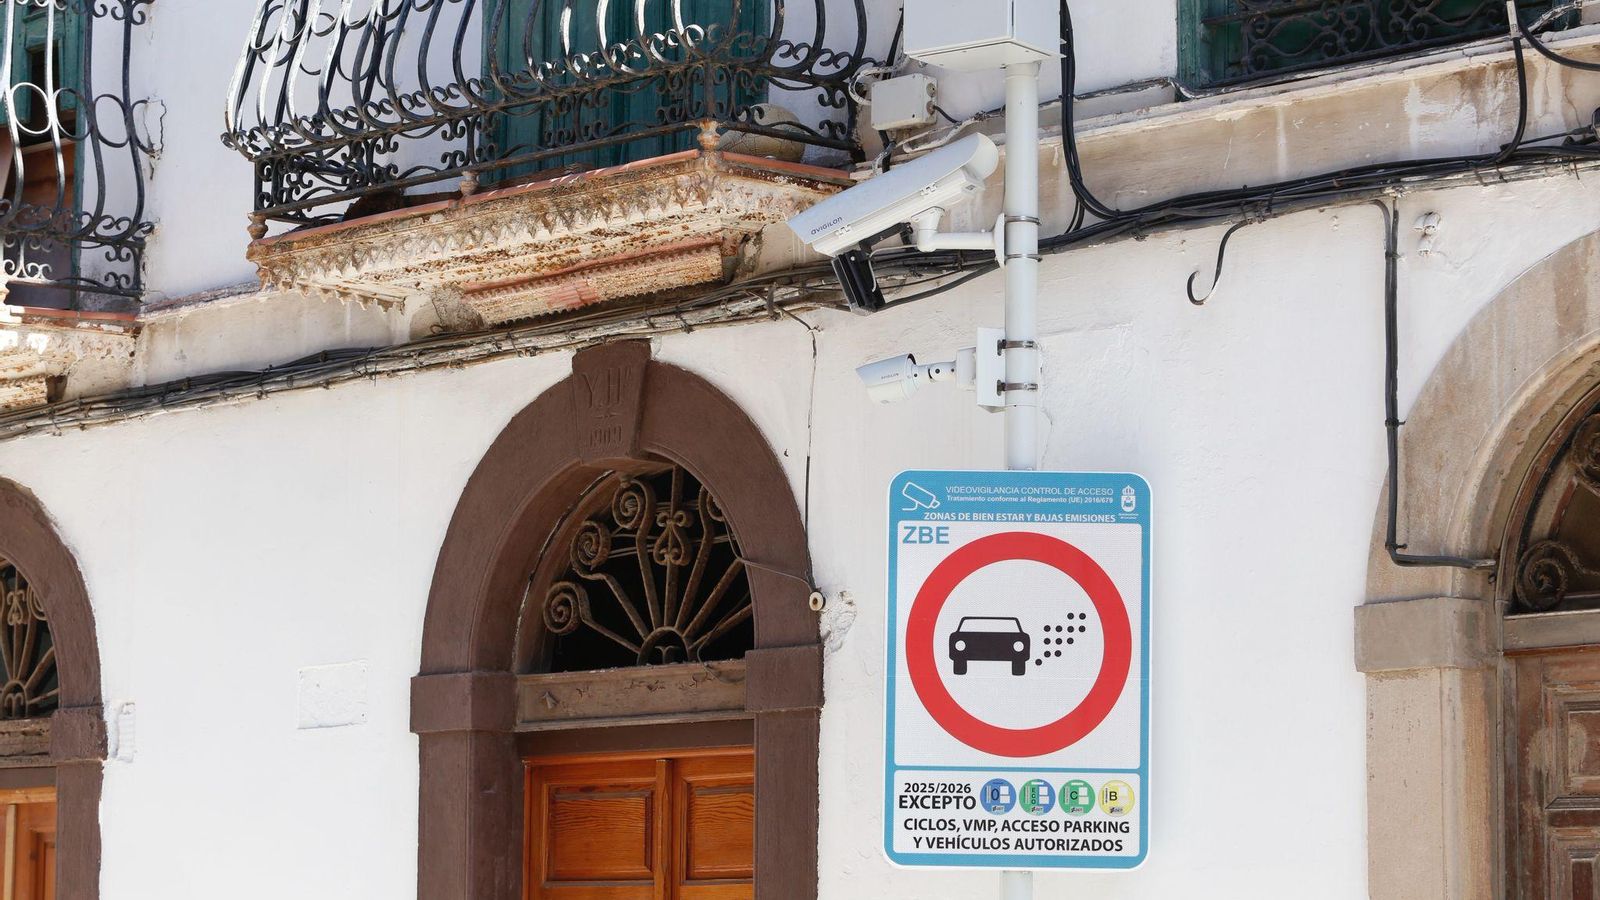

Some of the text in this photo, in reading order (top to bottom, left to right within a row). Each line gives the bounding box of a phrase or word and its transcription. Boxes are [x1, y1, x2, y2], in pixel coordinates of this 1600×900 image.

[946, 486, 1113, 496] VIDEOVIGILANCIA CONTROL DE ACCESO
[1028, 496, 1067, 504] Reglamento
[1068, 496, 1083, 504] (UE)
[924, 512, 956, 520] ZONAS
[996, 513, 1024, 521] ESTAR
[1026, 513, 1032, 521] Y
[1034, 514, 1063, 522] BAJAS
[1065, 514, 1116, 522] EMISIONES
[902, 525, 950, 544] ZBE
[904, 782, 971, 794] 2025/2026
[1070, 791, 1078, 800] C
[1109, 791, 1118, 801] B
[899, 795, 976, 809] EXCEPTO
[903, 818, 1130, 833] CICLOS, VMP, ACCESO PARKING
[913, 834, 1123, 851] Y VEHÍCULOS AUTORIZADOS
